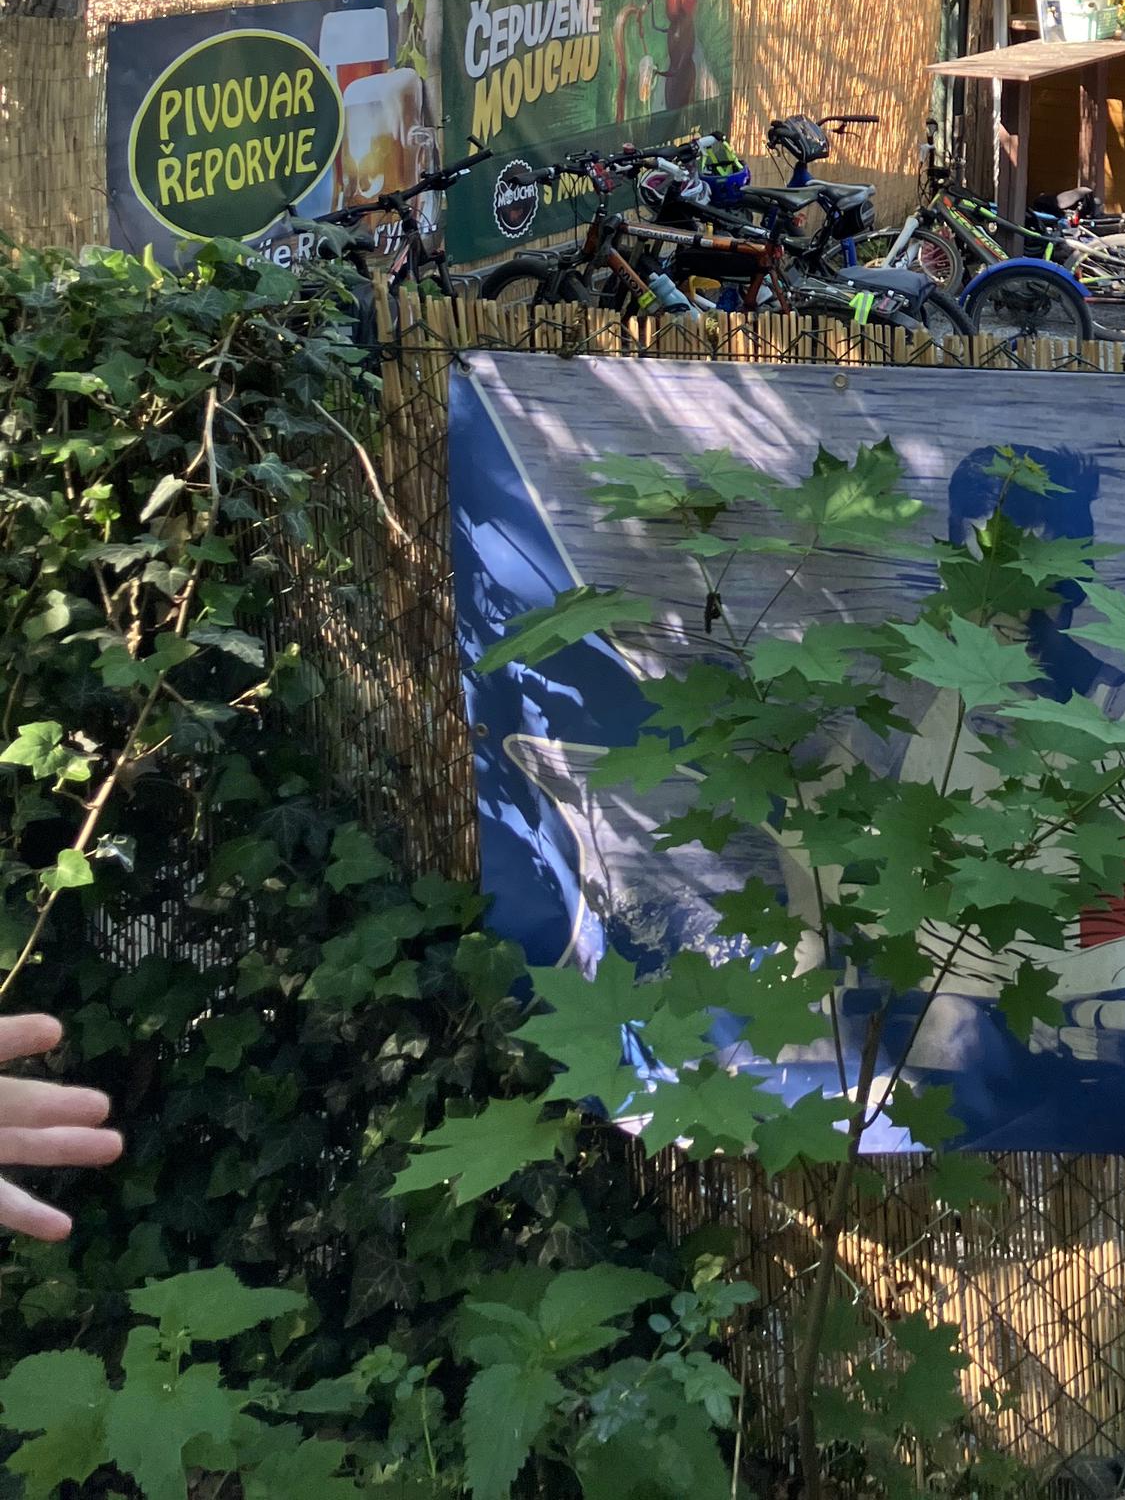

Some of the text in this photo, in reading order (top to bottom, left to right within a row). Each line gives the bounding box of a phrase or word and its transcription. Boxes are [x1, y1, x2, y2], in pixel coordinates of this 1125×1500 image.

[159, 68, 315, 141] PIVOVAR
[469, 35, 600, 156] MOUCHU
[157, 127, 317, 206] ŘEPORYJE
